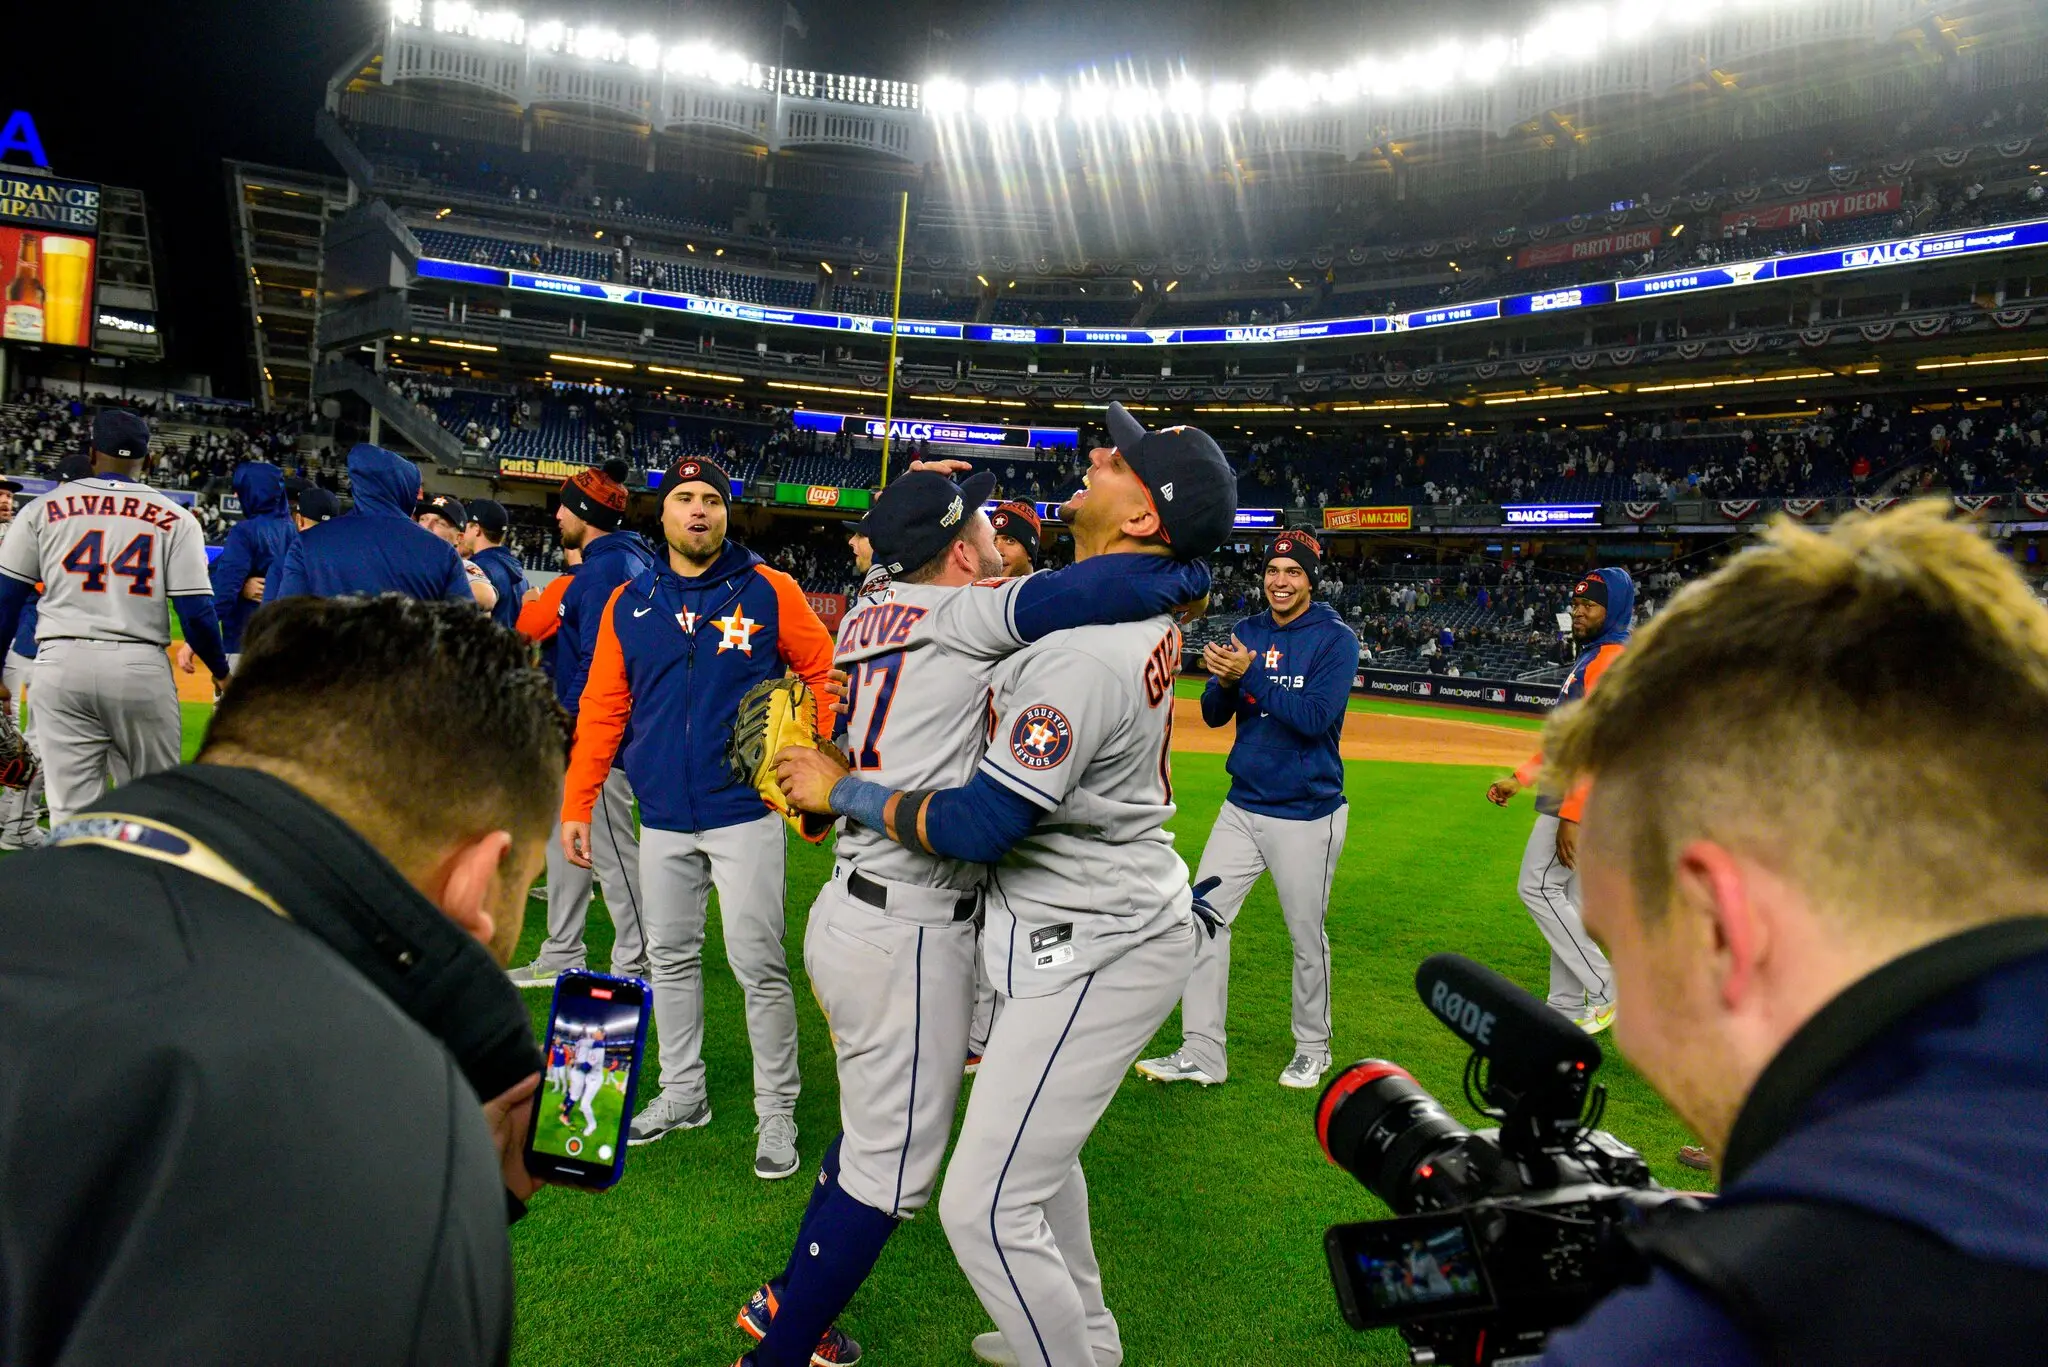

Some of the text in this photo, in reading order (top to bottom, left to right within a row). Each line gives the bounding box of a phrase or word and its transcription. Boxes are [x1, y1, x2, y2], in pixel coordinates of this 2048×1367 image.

[1789, 199, 1839, 223] PARTY
[1844, 191, 1889, 213] DECK
[1572, 238, 1613, 258] PARTY
[1616, 230, 1652, 251] DECK
[1868, 242, 1922, 264] ALCS
[1922, 239, 1964, 253] 2022
[535, 279, 581, 293] HOUSTON
[1645, 276, 1698, 292] HOUSTON
[1531, 290, 1582, 311] 2022
[705, 301, 738, 318] ALCS
[1425, 309, 1473, 323] NEW YORK
[914, 326, 937, 334] YORK
[991, 328, 1036, 342] 2022
[1086, 333, 1128, 341] HOUSTON
[1242, 328, 1277, 341] ALCS
[889, 422, 932, 440] ALCS
[933, 429, 967, 438] 2022
[500, 458, 535, 474] Parts
[808, 486, 838, 505] Lay's
[46, 494, 182, 532] ALVAREZ
[1331, 511, 1408, 527] MIKE'S AMAZING
[1521, 510, 1548, 522] ALCS
[62, 529, 156, 597] 44
[1372, 680, 1409, 692] loanDepot
[1440, 686, 1482, 699] loanDepot
[1027, 708, 1069, 736] HOUSTON
[1014, 743, 1050, 766] ASTROS
[1432, 980, 1497, 1046] RØDE
